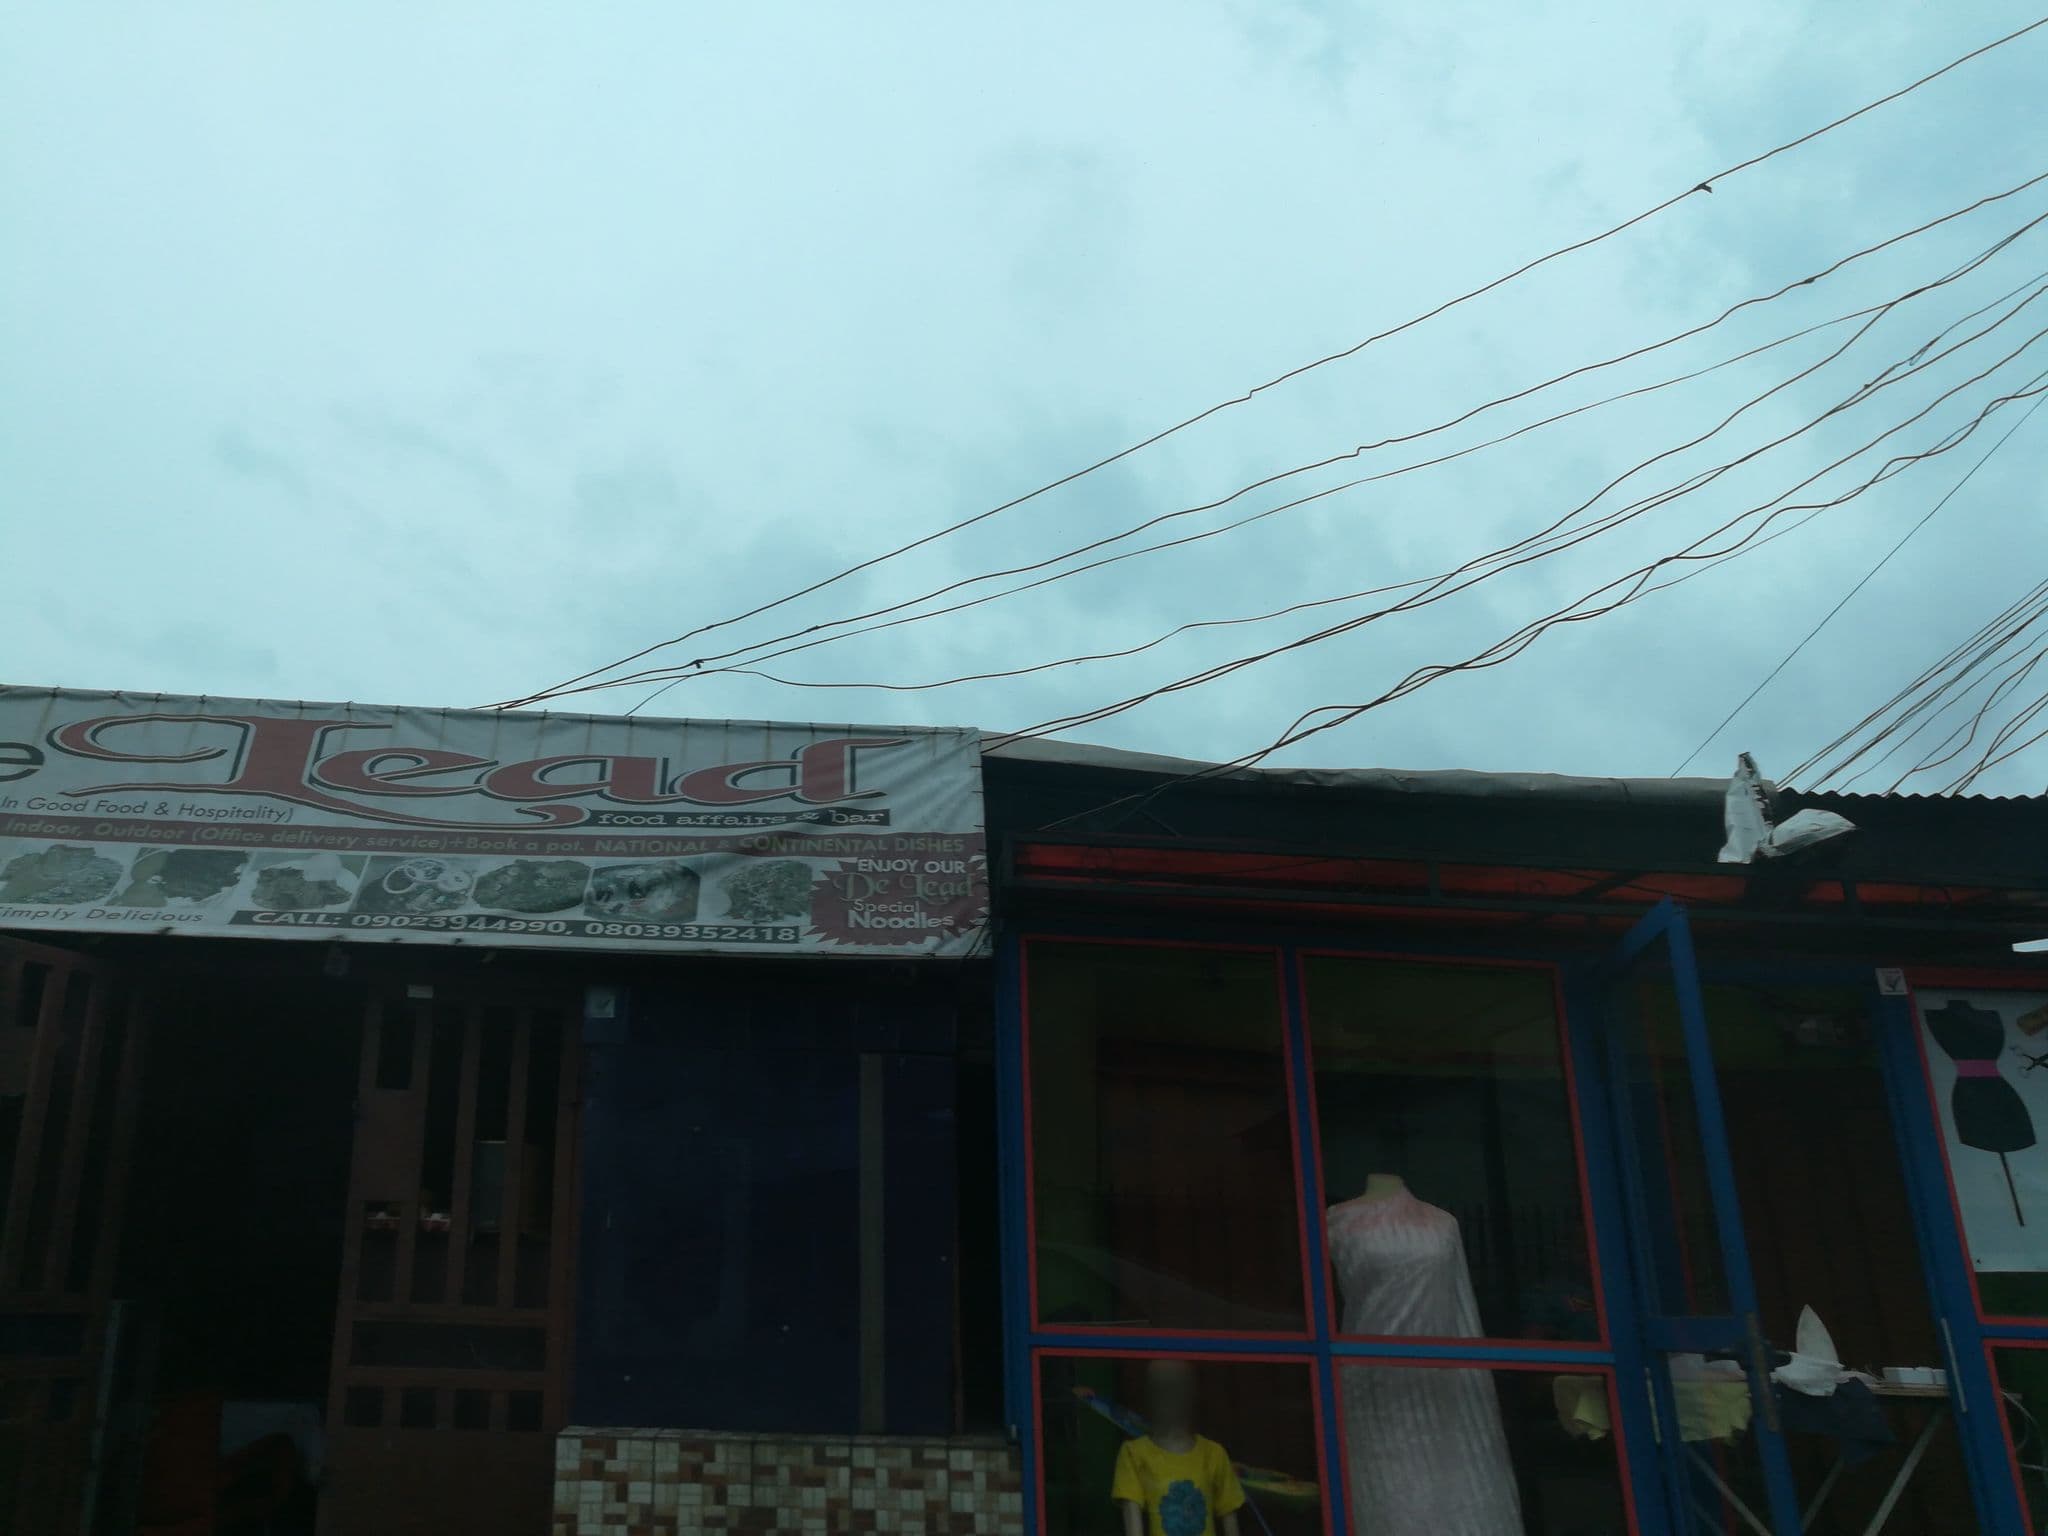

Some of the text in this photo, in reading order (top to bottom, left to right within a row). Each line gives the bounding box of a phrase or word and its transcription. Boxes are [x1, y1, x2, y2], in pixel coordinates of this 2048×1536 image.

[46, 713, 913, 830] Lead
[27, 797, 88, 812] Good
[94, 800, 148, 815] Food
[153, 803, 170, 816] &
[177, 803, 294, 823] Hospitality)
[598, 809, 885, 826] food affairs & bar
[6, 818, 82, 837] Indoor,
[94, 822, 184, 841] Outdoor
[191, 826, 265, 845] (Office
[271, 828, 359, 849] delivery
[527, 842, 538, 851] a
[594, 838, 707, 852] NATIONAL
[718, 839, 730, 849] &
[738, 835, 889, 853] CONTINENTAL
[893, 838, 965, 852] DISHES
[858, 858, 967, 874] ENJOY OUR
[832, 872, 890, 901] De
[0, 905, 203, 923] imply Delicious
[853, 898, 920, 913] Special
[252, 911, 342, 927] CALL:
[585, 921, 797, 942] 08039352418
[847, 909, 955, 929] Noodles
